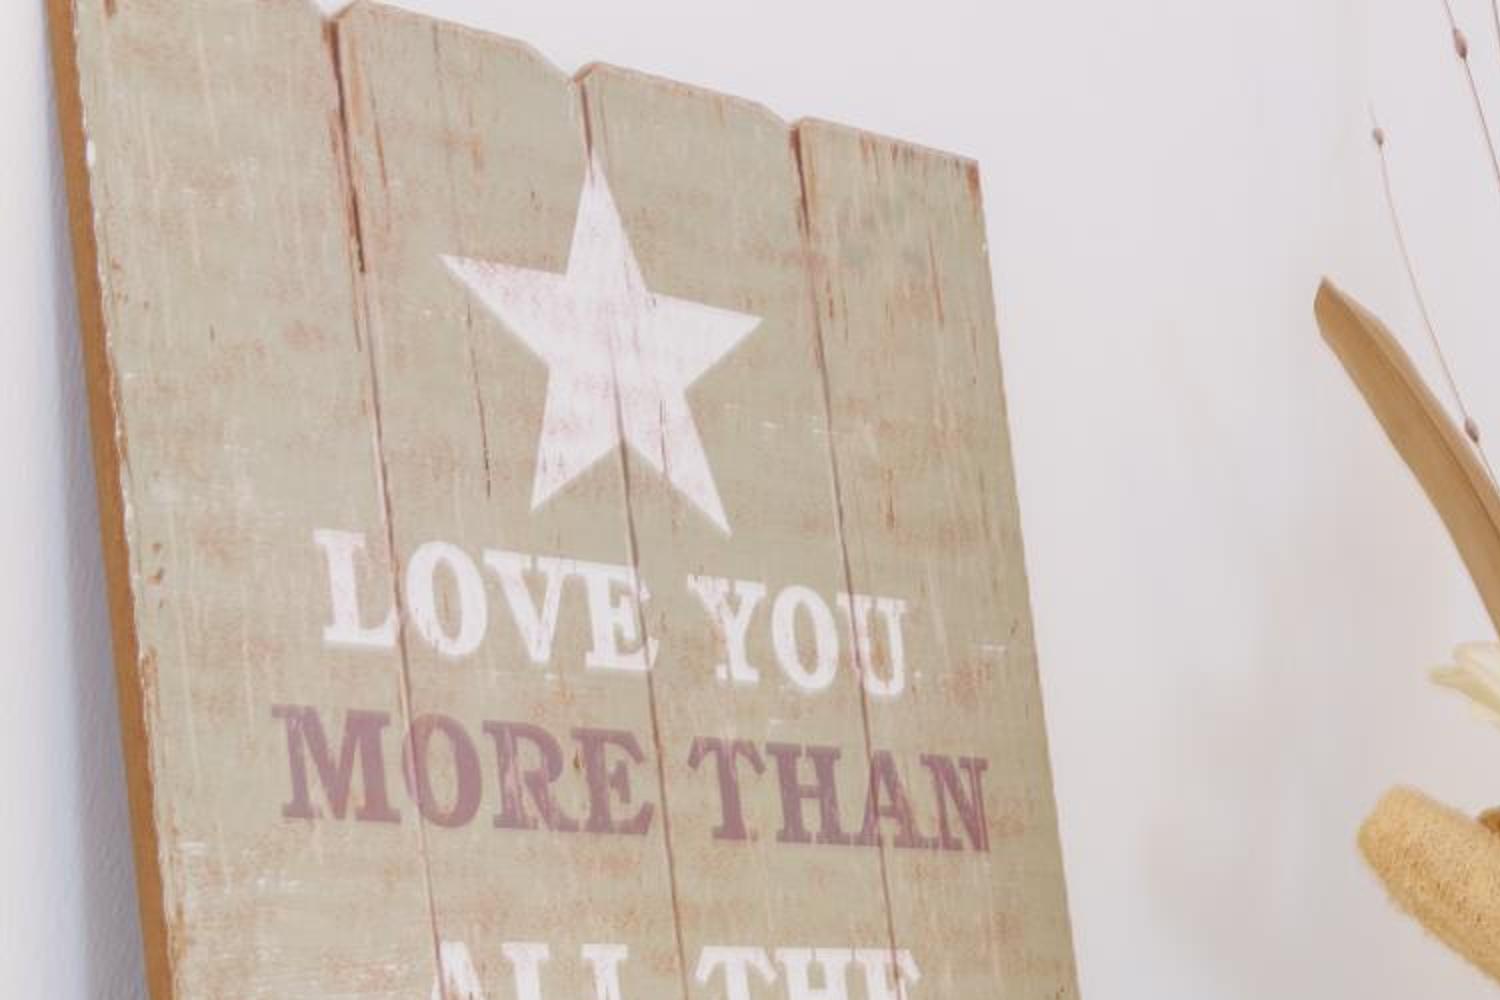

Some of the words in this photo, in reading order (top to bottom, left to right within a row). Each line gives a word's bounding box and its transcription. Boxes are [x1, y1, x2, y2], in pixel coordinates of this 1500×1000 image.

[314, 528, 661, 672] LOVE
[687, 572, 906, 695] YOU
[271, 703, 656, 835] MORE
[688, 736, 991, 853] THAN
